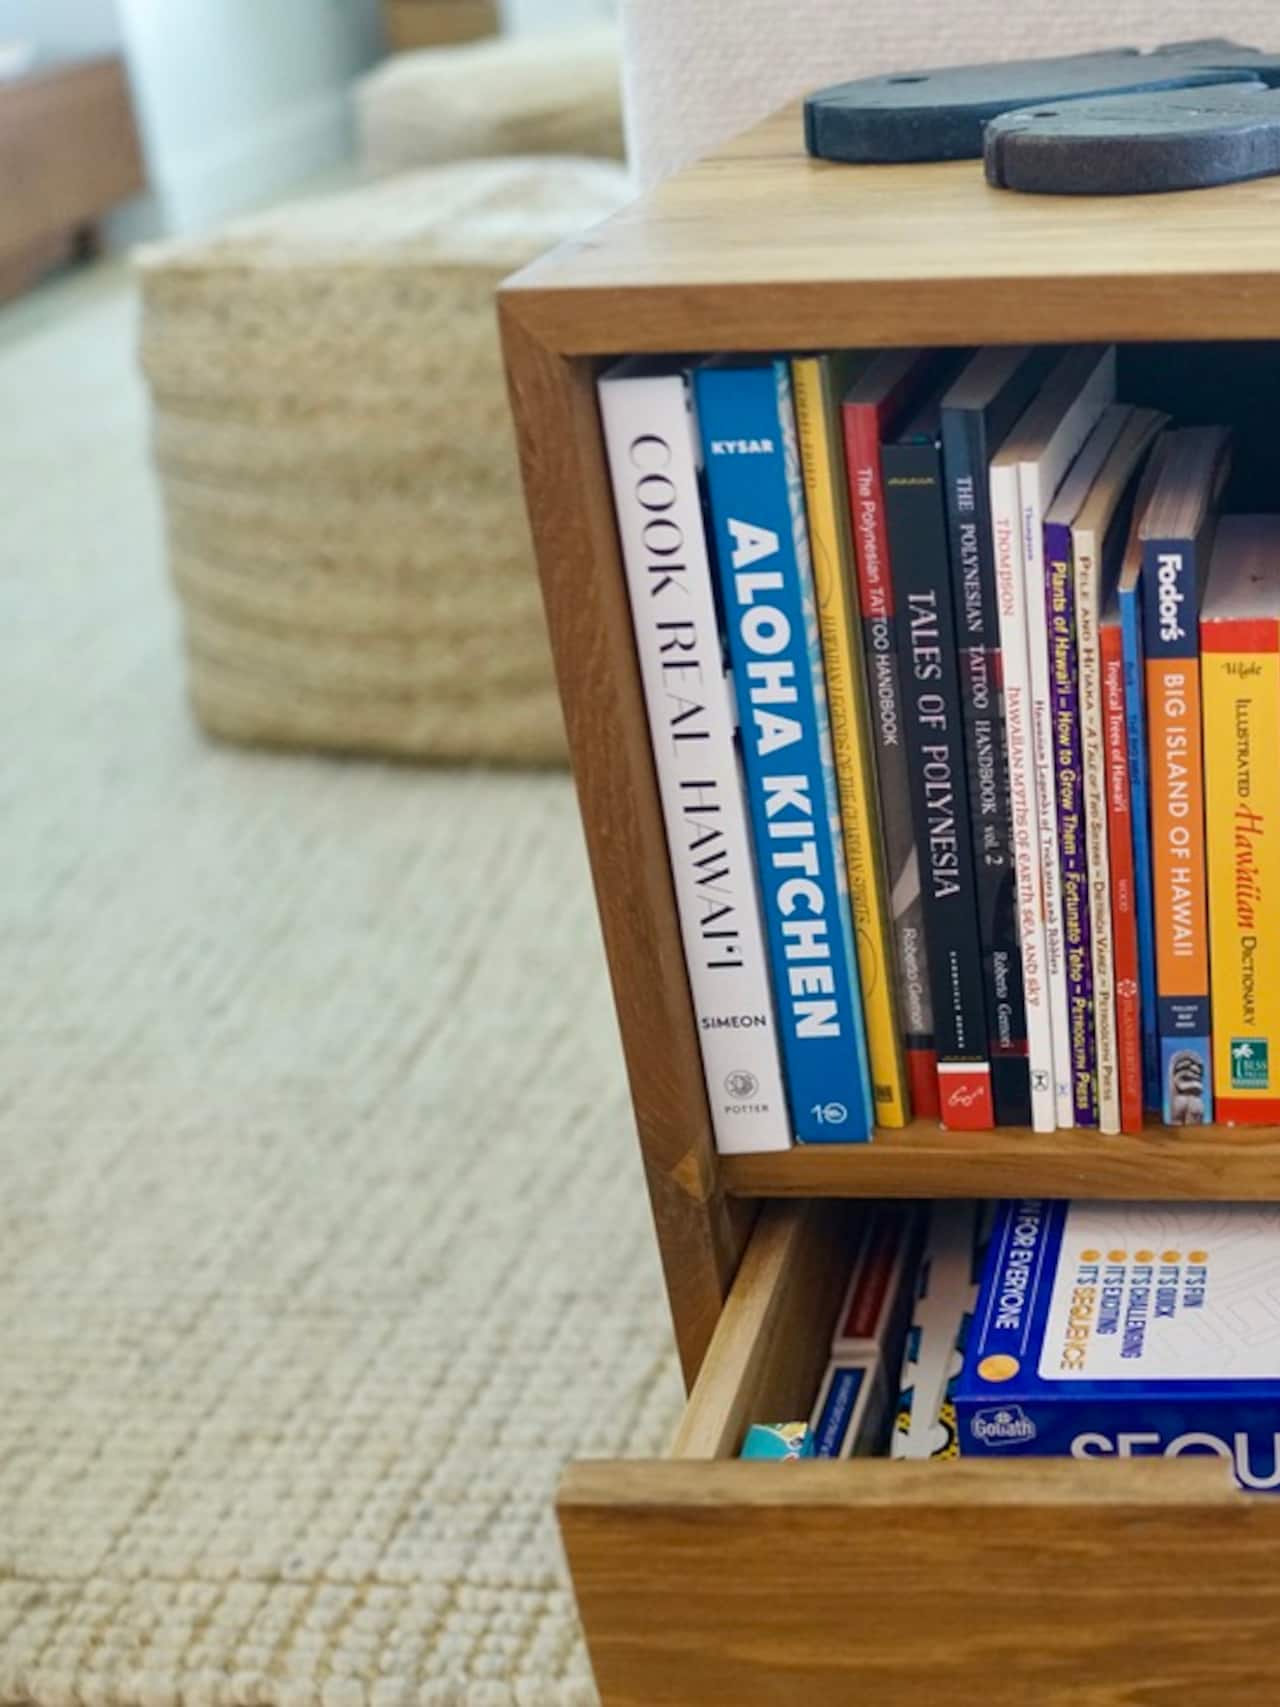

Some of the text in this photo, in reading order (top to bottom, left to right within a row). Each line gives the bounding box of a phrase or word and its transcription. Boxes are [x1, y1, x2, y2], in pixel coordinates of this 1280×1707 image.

[711, 439, 774, 455] KYSAR
[629, 434, 688, 597] COOK
[956, 475, 974, 511] THE
[959, 523, 983, 632] POLYNESIAN
[1051, 560, 1067, 611] Plants
[1158, 553, 1183, 641] Fodor's
[856, 466, 897, 747] The Polynesian TATTOO HANDBOOK
[1053, 616, 1068, 632] of
[656, 621, 710, 756] REAL
[968, 644, 989, 709] TATTOO
[1105, 660, 1122, 711] Tropical
[908, 589, 959, 898] TALES OF POLYNESIA
[1057, 711, 1073, 746] How
[1109, 713, 1123, 745] Trees
[727, 518, 840, 1039] ALOHA KITCHEN
[974, 719, 996, 814] HANDBOOK
[1059, 749, 1073, 765] to
[1111, 749, 1123, 763] of
[1036, 764, 1051, 815] Legends
[1060, 769, 1076, 809] Grow
[1062, 814, 1078, 854] Them
[1163, 673, 1192, 955] BIG ISLAND OF HAWAII
[985, 853, 1003, 865] 2
[1233, 803, 1264, 929] Hawaiian
[1064, 871, 1083, 943] Fortunato
[901, 927, 920, 980] Roberto
[992, 951, 1010, 998] Roberto
[1024, 942, 1037, 974] AND
[1068, 946, 1084, 980] Teho
[702, 1015, 767, 1029] SIMEON
[724, 1104, 769, 1115] POTTER
[1012, 1215, 1040, 1247] FOR
[996, 1249, 1033, 1329] EVERYONE
[1096, 1287, 1123, 1334] EXCITING
[1154, 1287, 1177, 1318] QUICK
[1183, 1287, 1205, 1308] FUN
[1060, 1287, 1096, 1369] SEQUENCE
[1120, 1287, 1150, 1358] CHALLENGING
[974, 1419, 1033, 1437] Goliath
